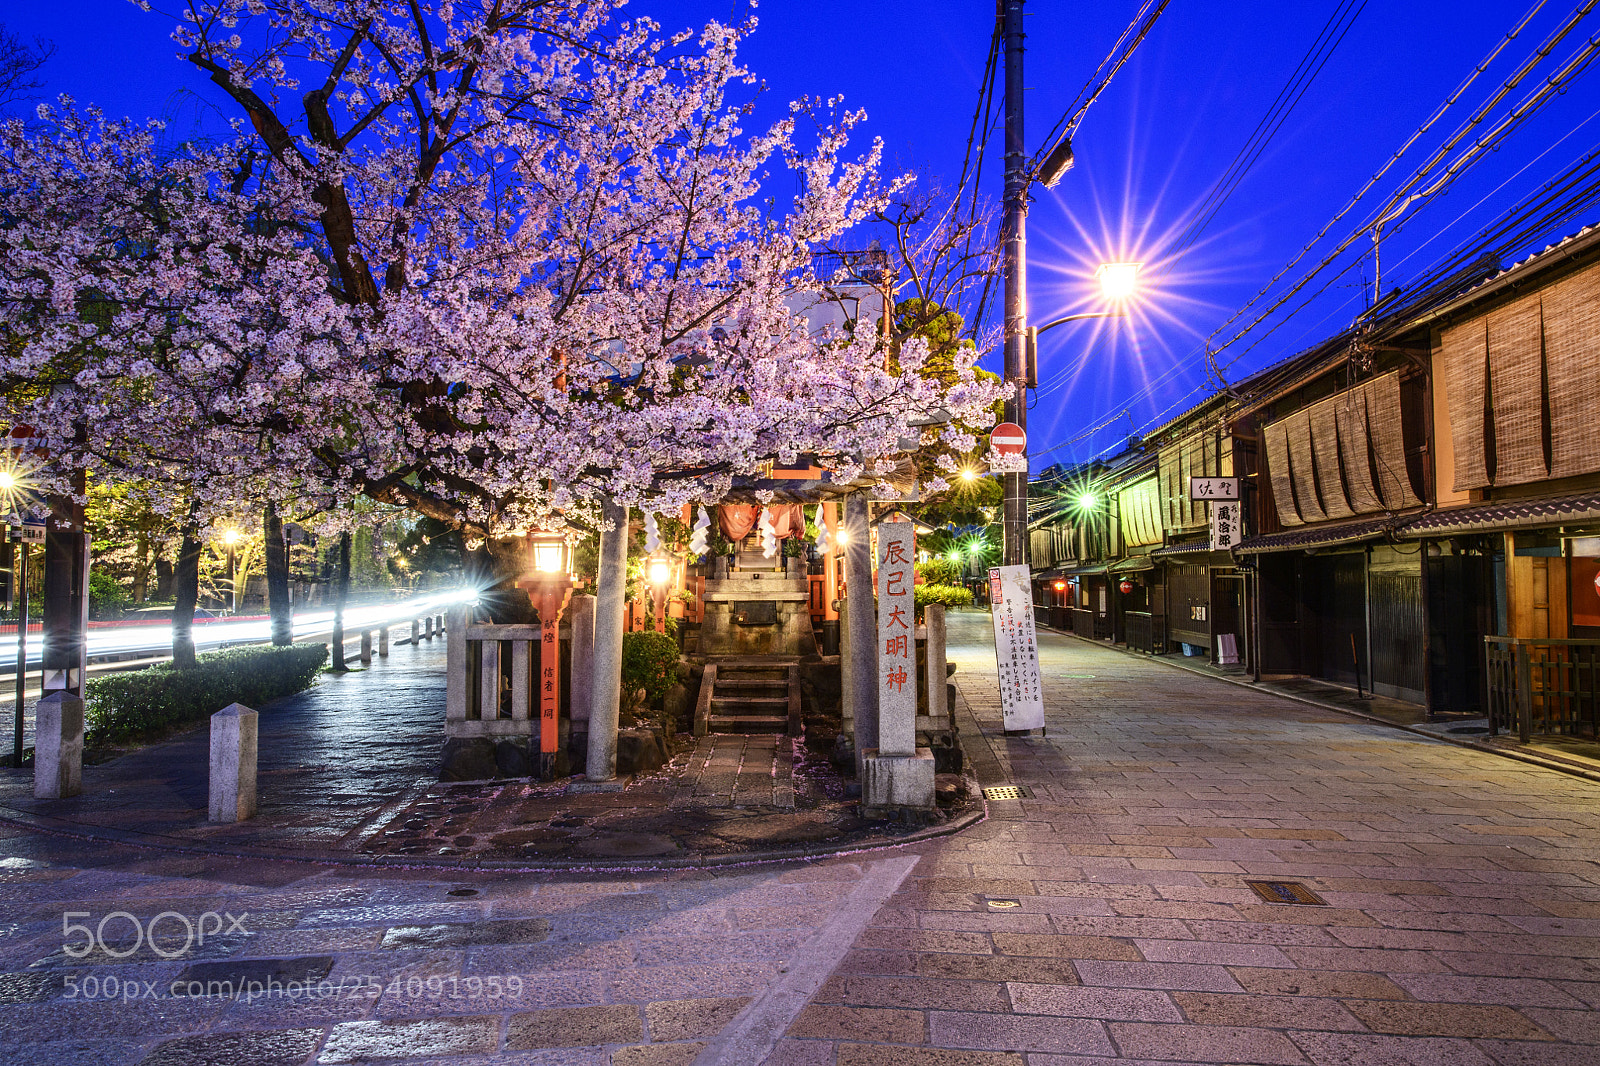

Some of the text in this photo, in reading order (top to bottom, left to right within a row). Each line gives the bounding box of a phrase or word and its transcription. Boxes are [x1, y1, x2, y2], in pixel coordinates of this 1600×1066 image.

[1218, 505, 1231, 547] 萬治郎
[543, 667, 554, 719] 信者一同
